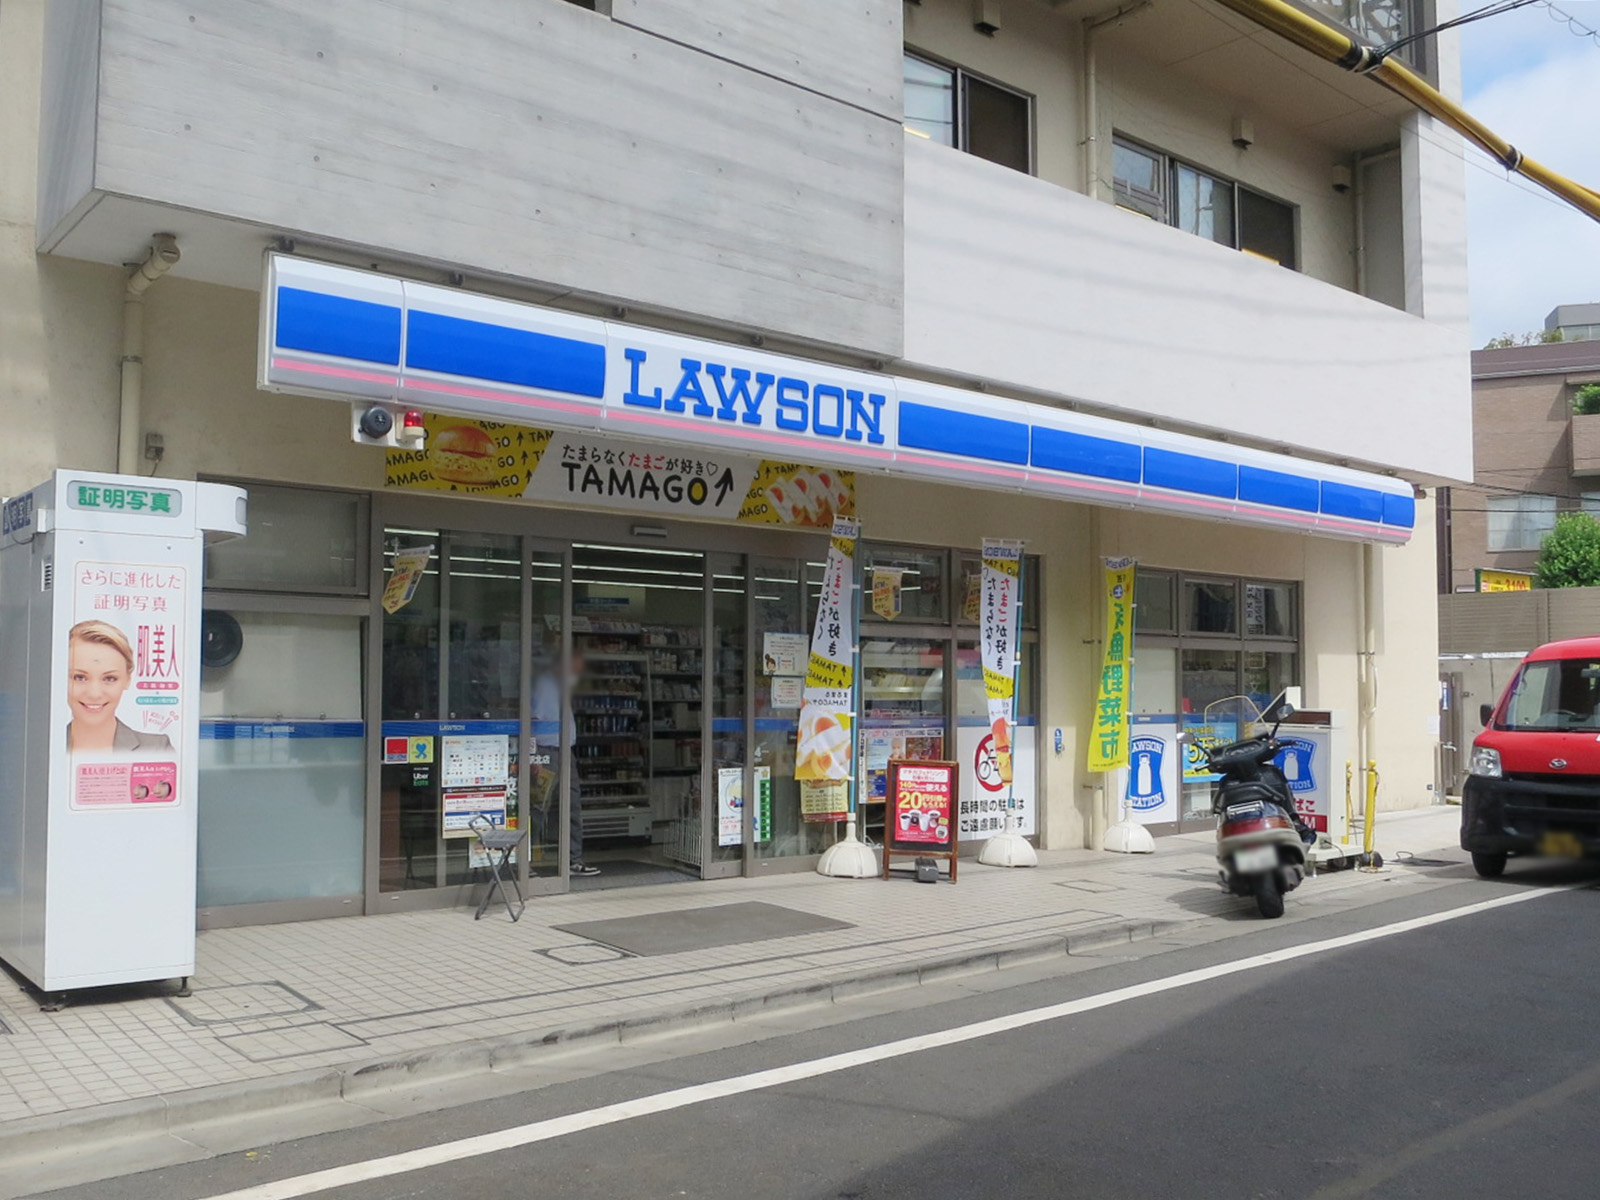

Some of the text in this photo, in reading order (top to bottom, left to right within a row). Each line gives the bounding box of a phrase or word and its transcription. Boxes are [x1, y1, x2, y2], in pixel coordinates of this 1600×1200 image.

[623, 347, 886, 444] LAWSON
[562, 444, 704, 475] たまらなくたまごが好き
[561, 461, 708, 506] TAMAGO
[78, 486, 171, 513] 証明写真
[81, 569, 181, 589] さらに進化した
[94, 594, 167, 612] 証明写真
[137, 624, 180, 677] 肌美人
[1132, 740, 1162, 754] AWSON
[898, 791, 922, 809] 20
[960, 798, 1024, 814] 長時間の駐は
[1132, 793, 1162, 807] TATION
[1294, 799, 1315, 812] ばこ
[961, 816, 1028, 832] ご遠慮願いす。
